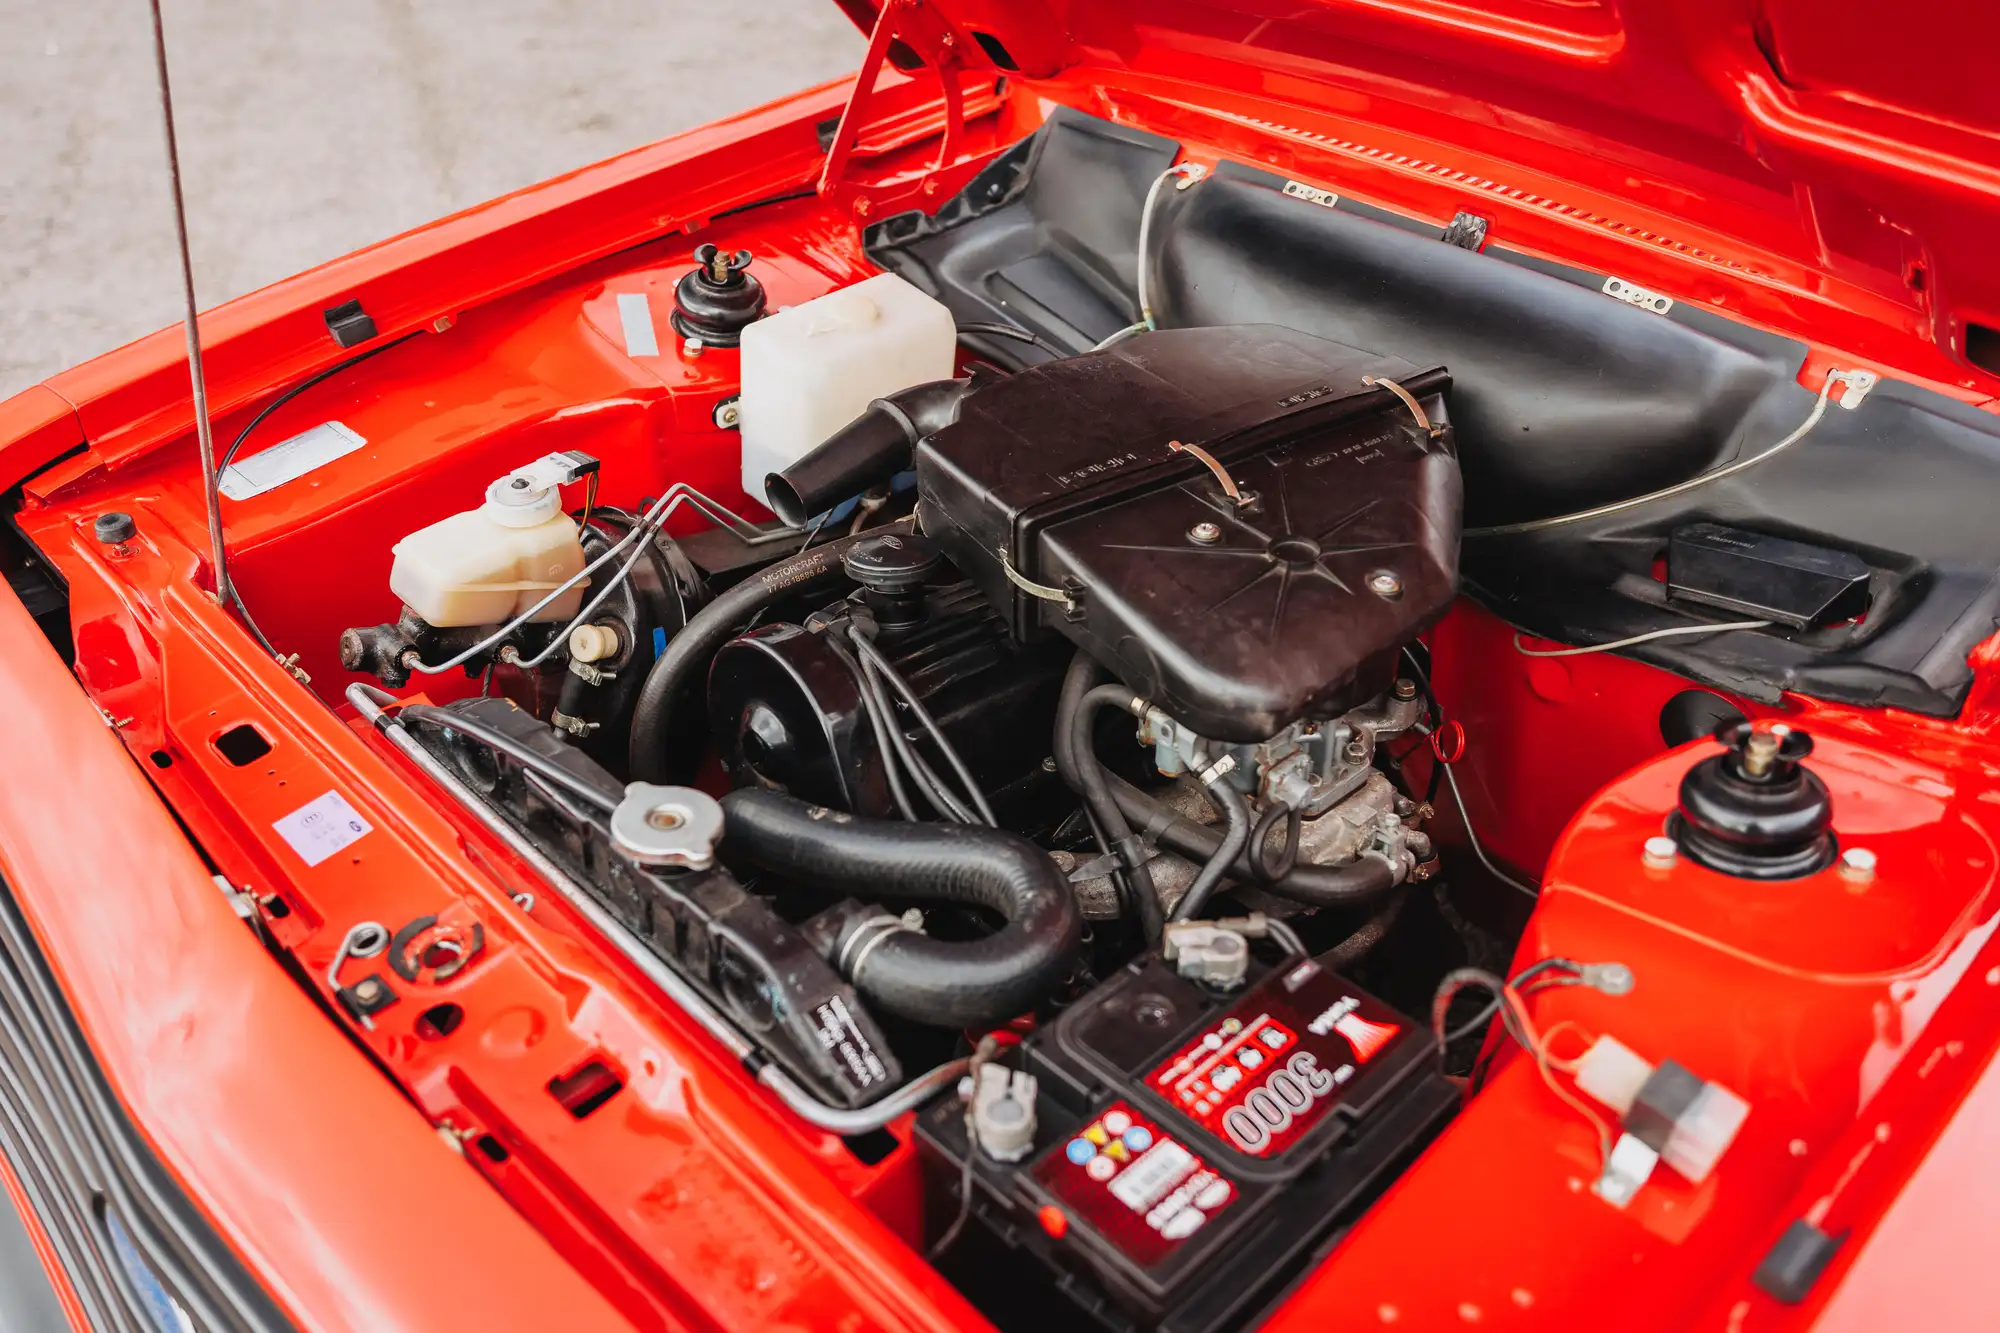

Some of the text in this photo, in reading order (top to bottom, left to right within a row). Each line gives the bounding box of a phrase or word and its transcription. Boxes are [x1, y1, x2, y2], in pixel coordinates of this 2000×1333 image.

[762, 553, 824, 584] MOTORCRAFT
[779, 578, 791, 589] AG
[1222, 1051, 1334, 1154] 3000
